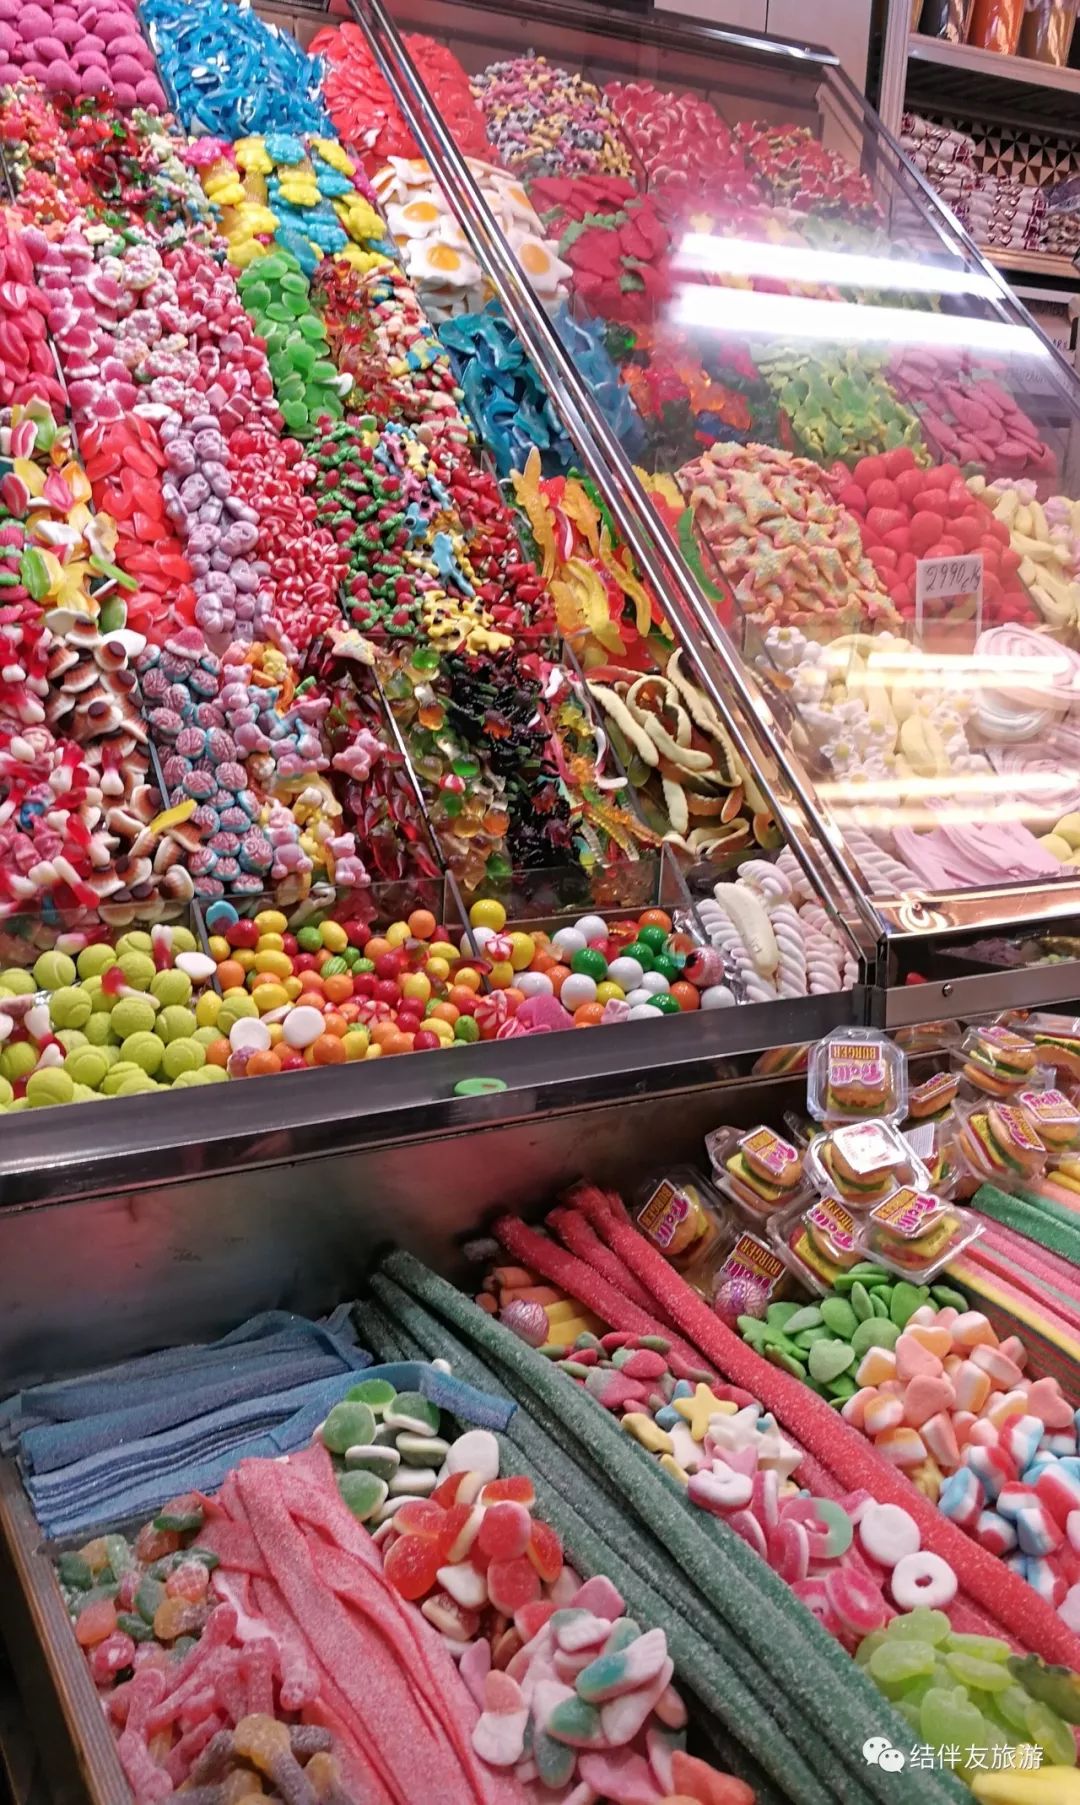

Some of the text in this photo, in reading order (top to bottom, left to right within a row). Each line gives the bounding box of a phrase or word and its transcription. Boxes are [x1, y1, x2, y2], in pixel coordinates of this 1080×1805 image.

[833, 1046, 876, 1059] BURGER
[831, 1063, 881, 1082] Trolli
[810, 1209, 853, 1248] Trolli
[897, 1196, 936, 1230] Trolli
[740, 1238, 781, 1276] BURGER
